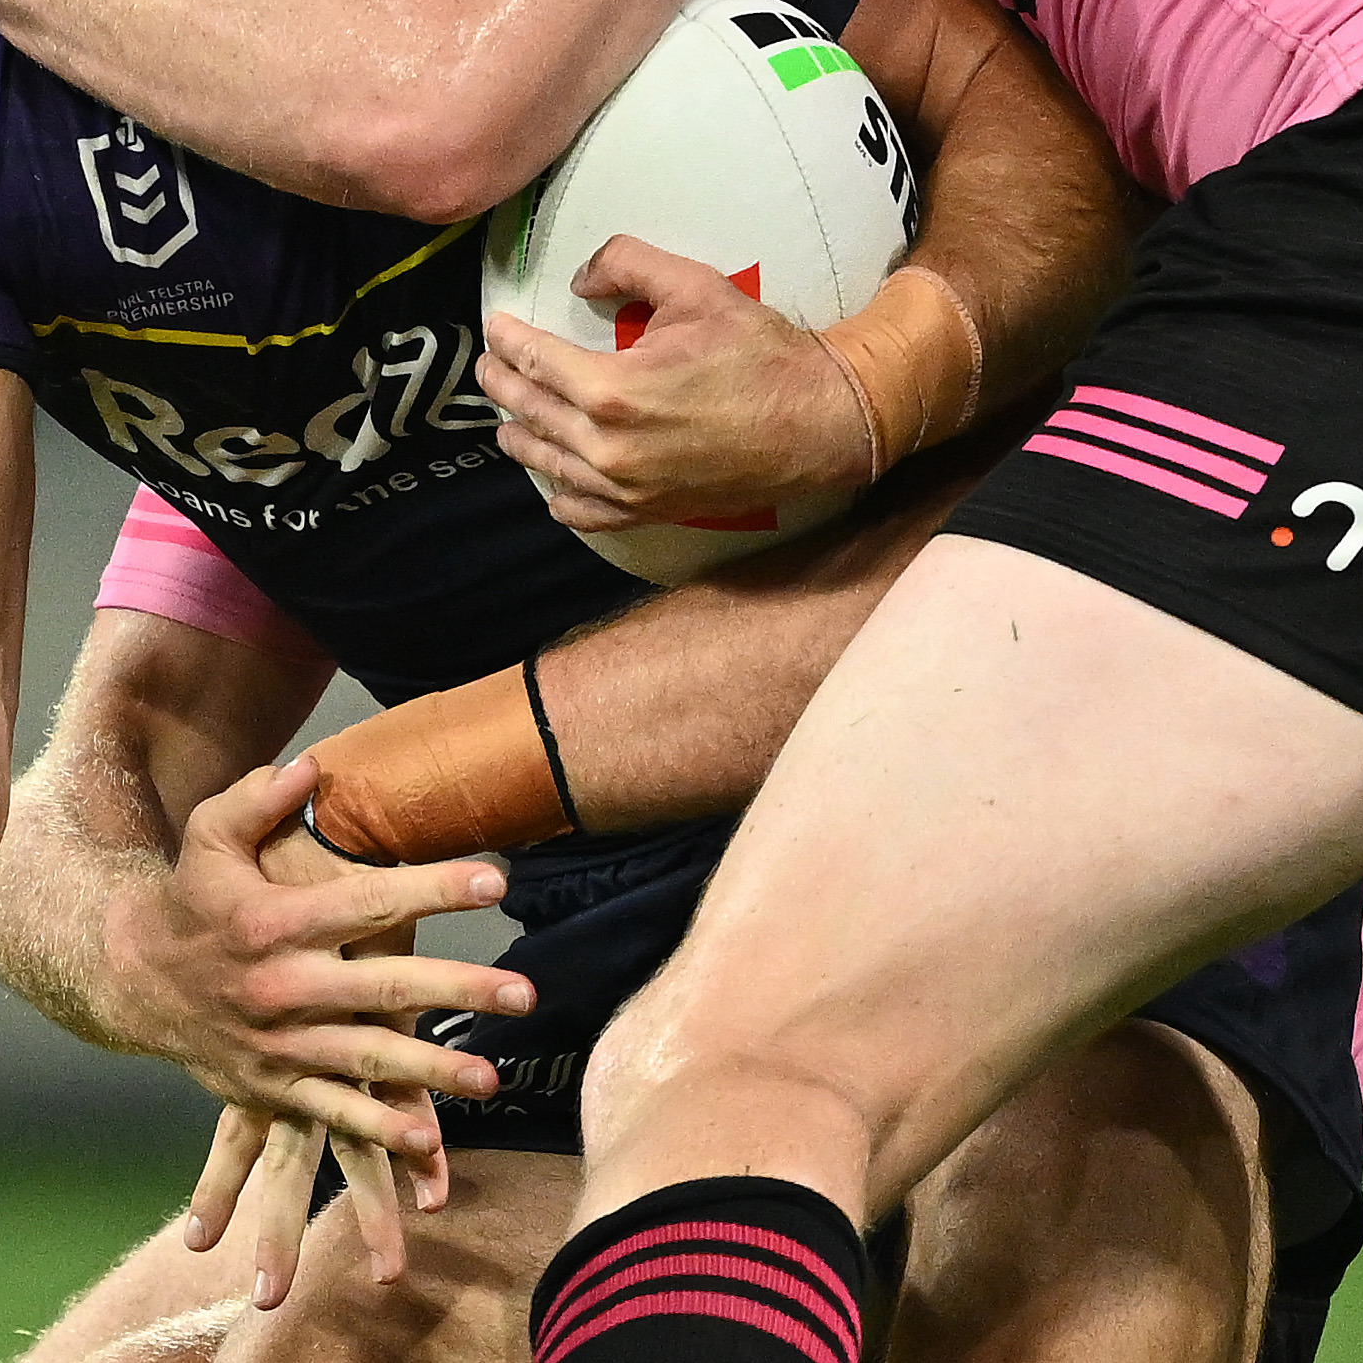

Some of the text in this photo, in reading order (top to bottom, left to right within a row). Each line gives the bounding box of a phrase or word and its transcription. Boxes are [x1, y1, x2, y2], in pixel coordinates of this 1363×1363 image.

[148, 279, 216, 301] TELSTRA
[107, 292, 235, 324] PREMIERSHIP
[262, 504, 321, 532] for
